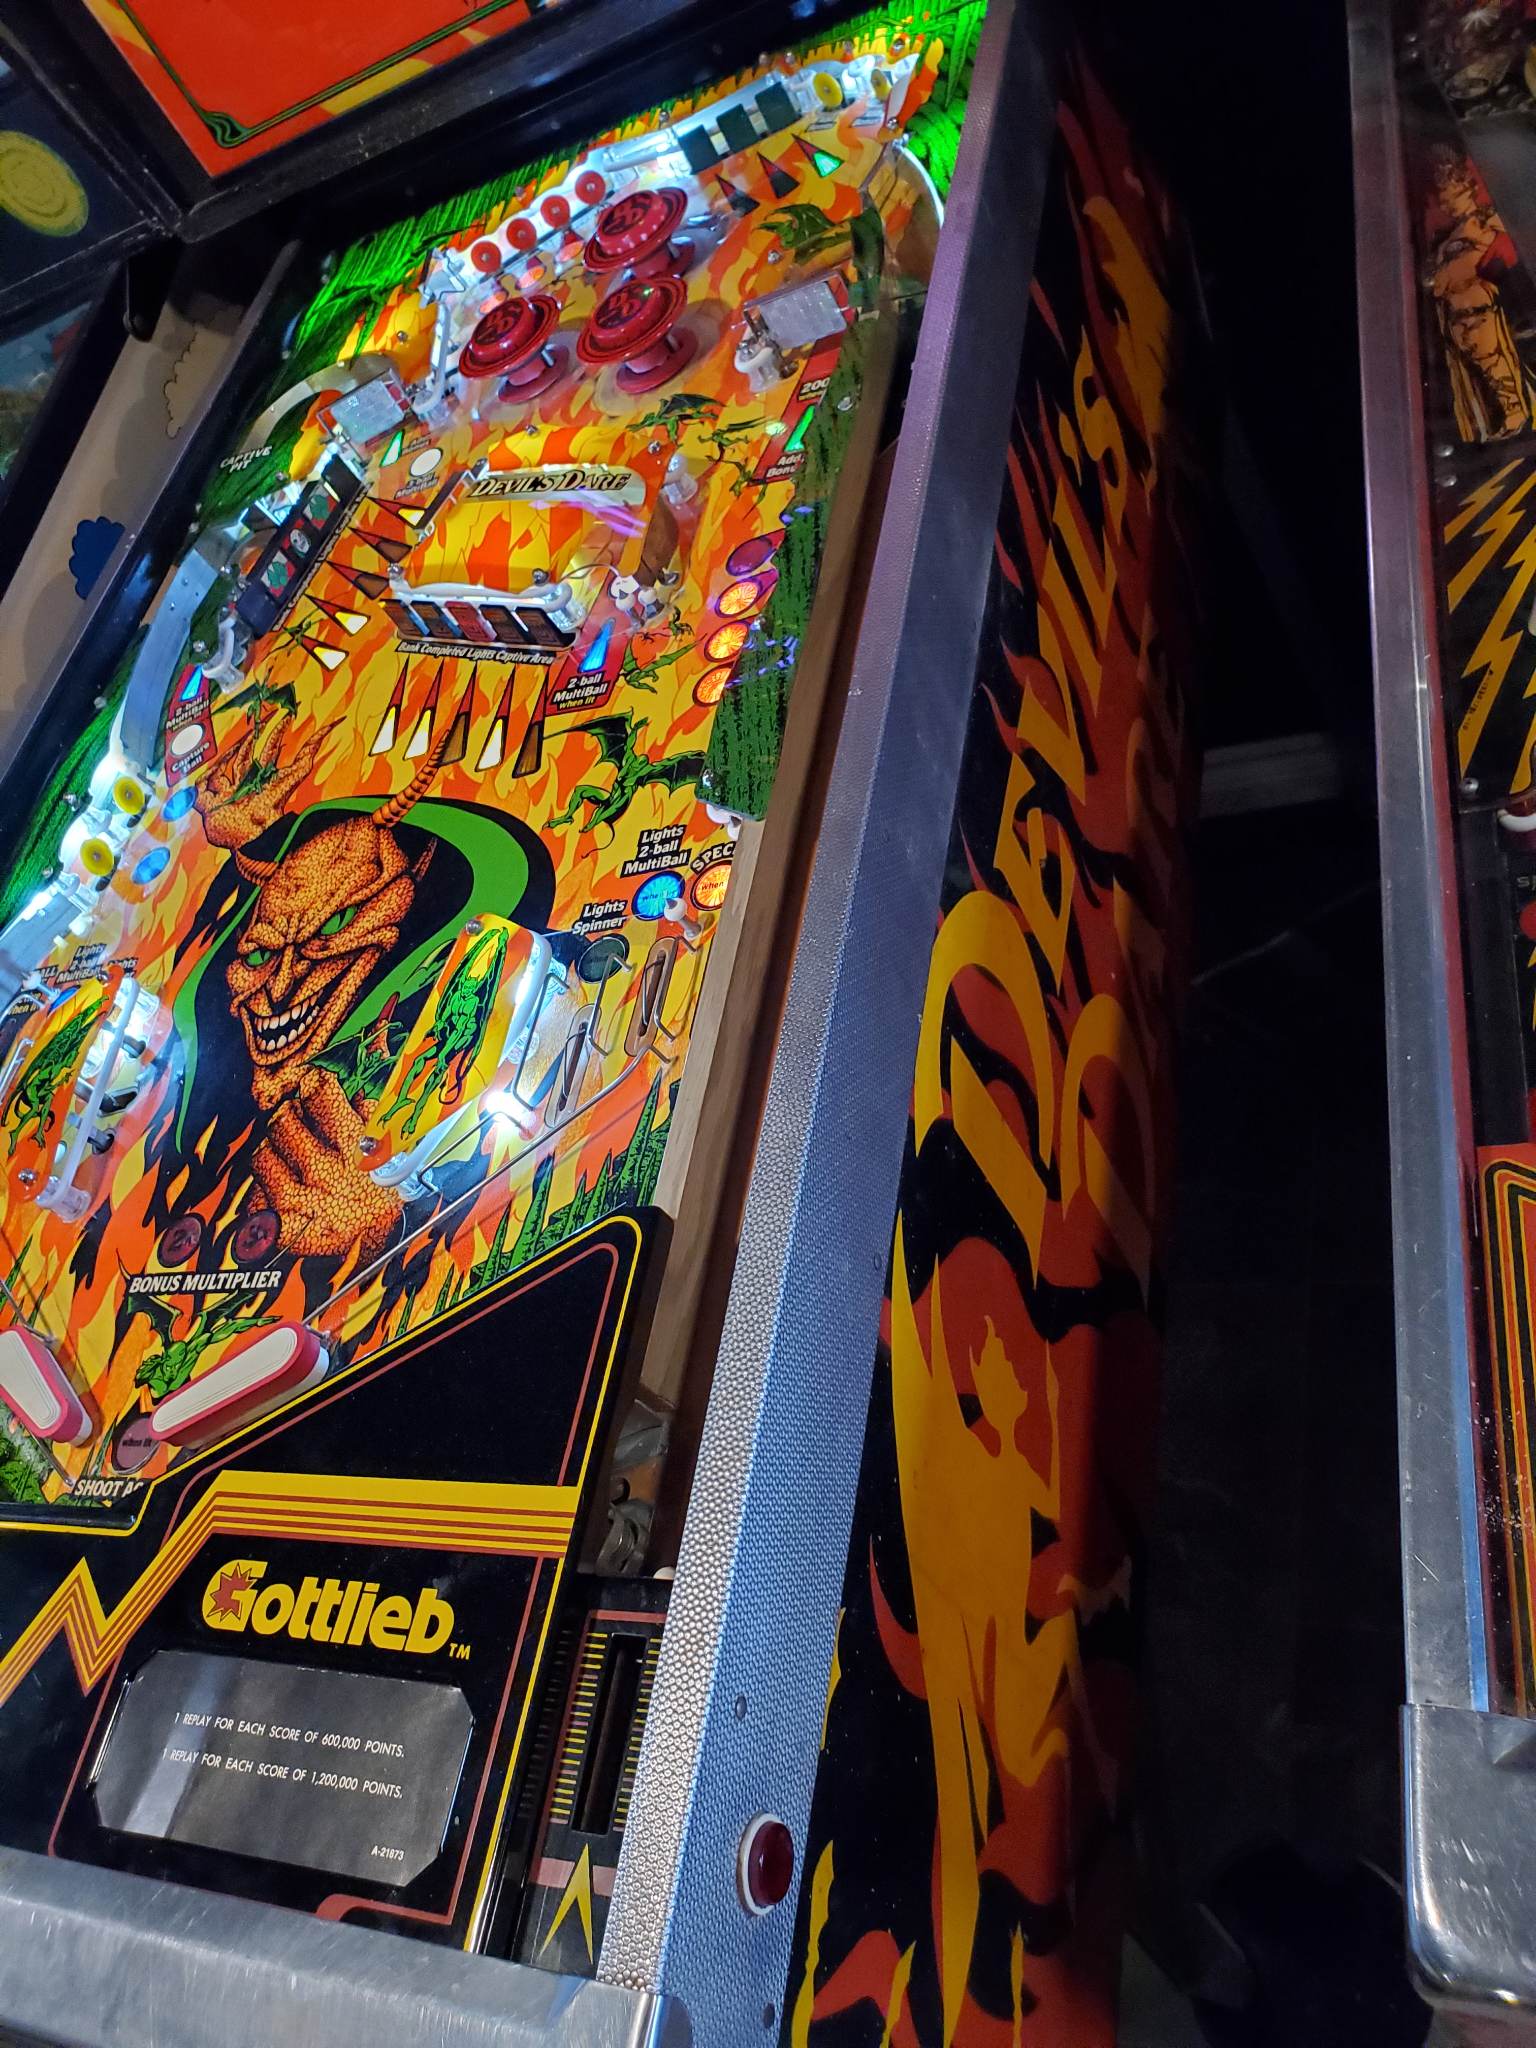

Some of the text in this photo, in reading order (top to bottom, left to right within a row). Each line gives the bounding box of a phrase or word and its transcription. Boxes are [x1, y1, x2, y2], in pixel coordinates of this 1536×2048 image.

[554, 470, 632, 491] DARE
[399, 641, 420, 653] Bank
[567, 672, 603, 689] 2-ball
[553, 683, 608, 703] MultiBall
[171, 742, 210, 773] Capture
[641, 826, 684, 846] Lights
[637, 840, 679, 859] 2-ball
[691, 843, 736, 872] SPEC
[623, 852, 688, 875] MultiBall
[583, 901, 626, 919] Lights
[572, 916, 625, 935] Spinner
[129, 1271, 282, 1293] BONUS MULTIPLIER
[74, 1480, 123, 1497] SHOOT
[201, 1558, 456, 1654] Gottlieb
[182, 1713, 212, 1727] REPLAY
[214, 1717, 234, 1731] FOR
[238, 1720, 266, 1736] EACH
[268, 1725, 301, 1742] SCORE
[304, 1731, 319, 1743] OF
[321, 1733, 361, 1751] 600,000
[364, 1740, 405, 1758] POINTS.
[170, 1749, 199, 1764] REPLAY
[201, 1753, 221, 1768] FOR
[225, 1757, 254, 1773] EACH
[257, 1763, 290, 1779] SCORE
[292, 1768, 307, 1781] OF
[311, 1771, 358, 1791] 1,200,000
[362, 1780, 403, 1799] POINTS.
[371, 1845, 405, 1861] A-21873
